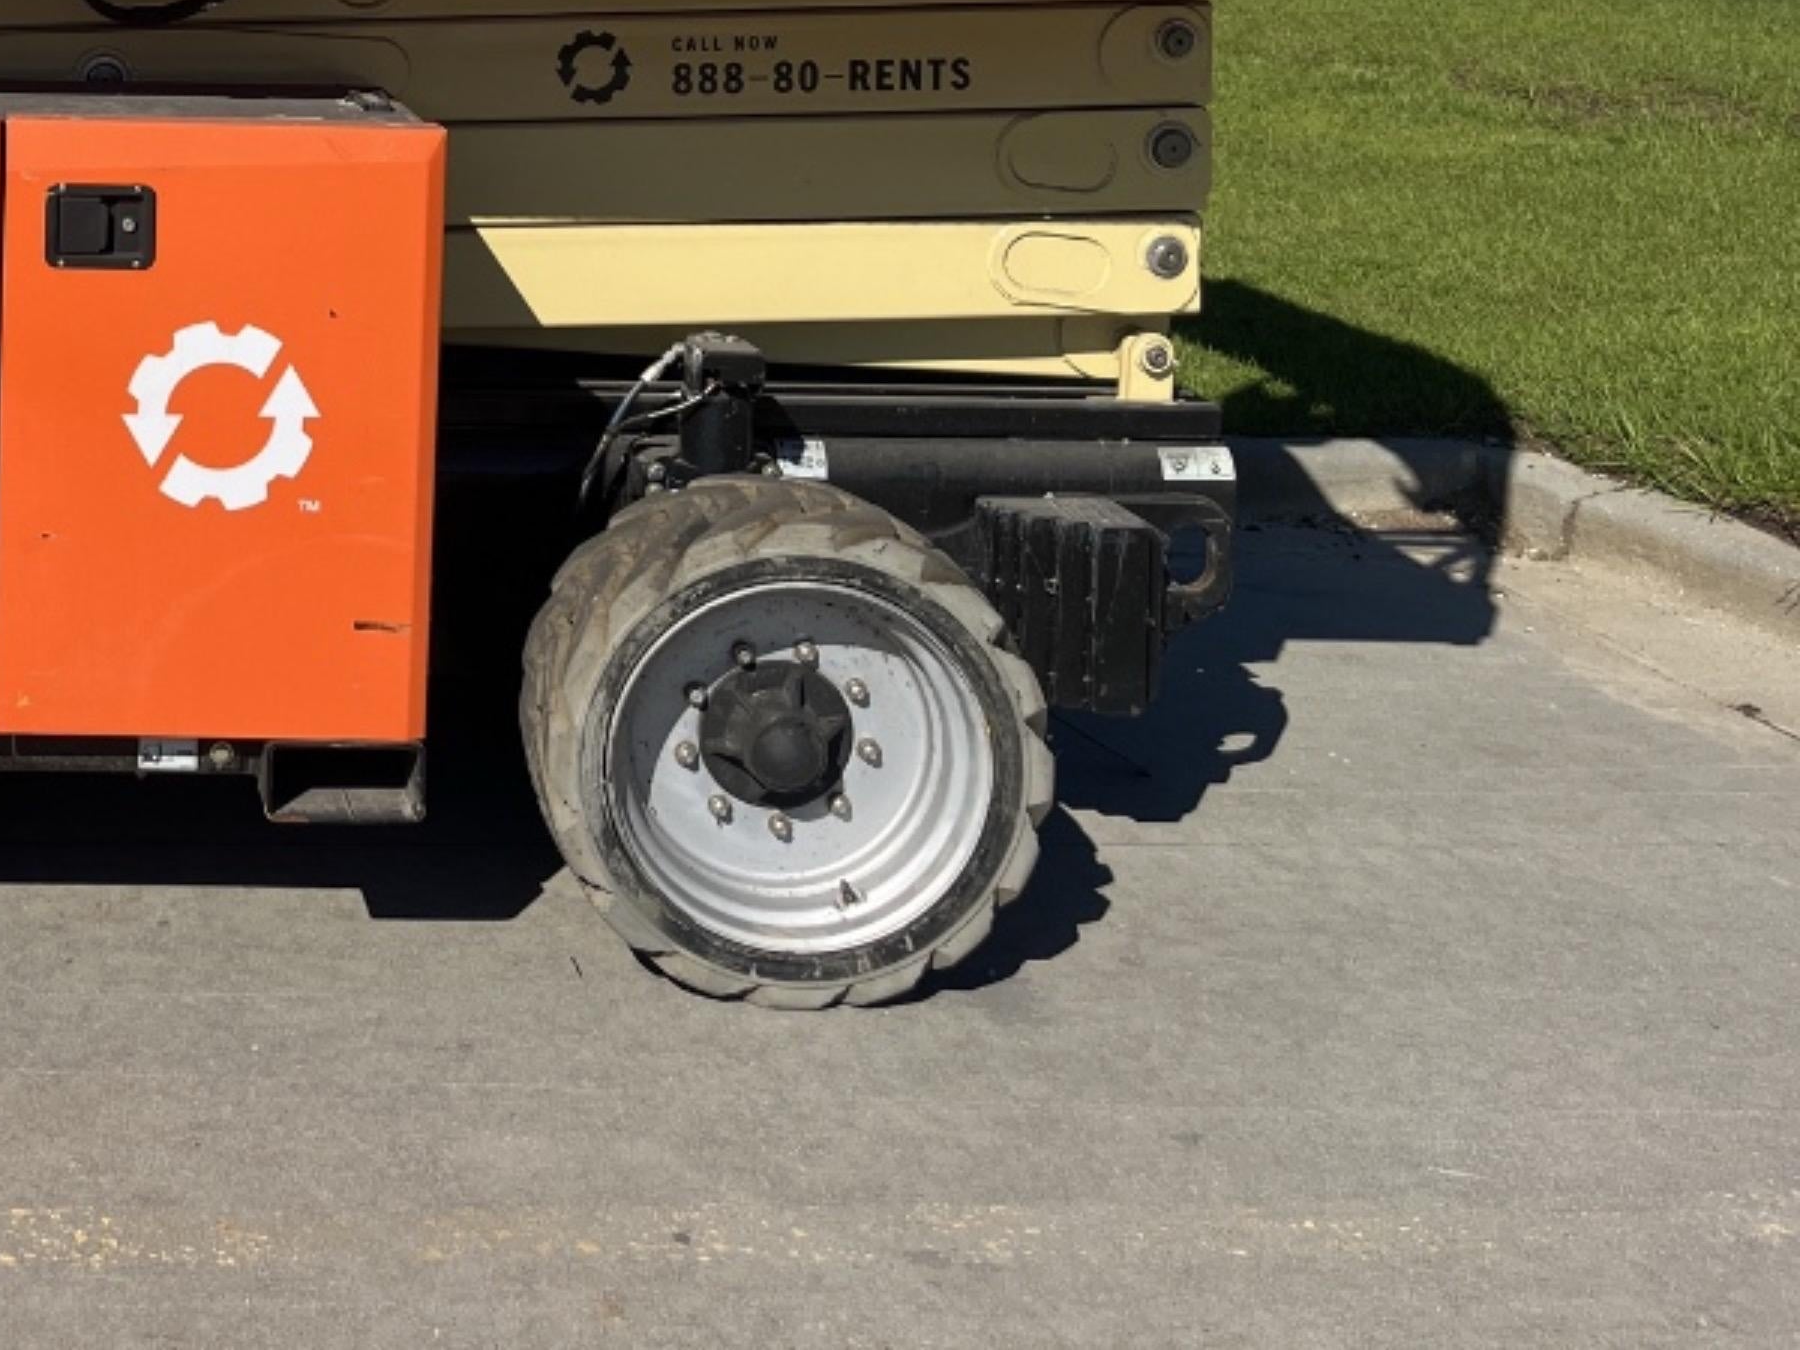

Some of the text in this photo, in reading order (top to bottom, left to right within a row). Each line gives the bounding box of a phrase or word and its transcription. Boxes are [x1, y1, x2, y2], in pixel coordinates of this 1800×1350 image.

[671, 35, 779, 52] CALL NOW
[671, 56, 971, 96] 888-80-RENTS
